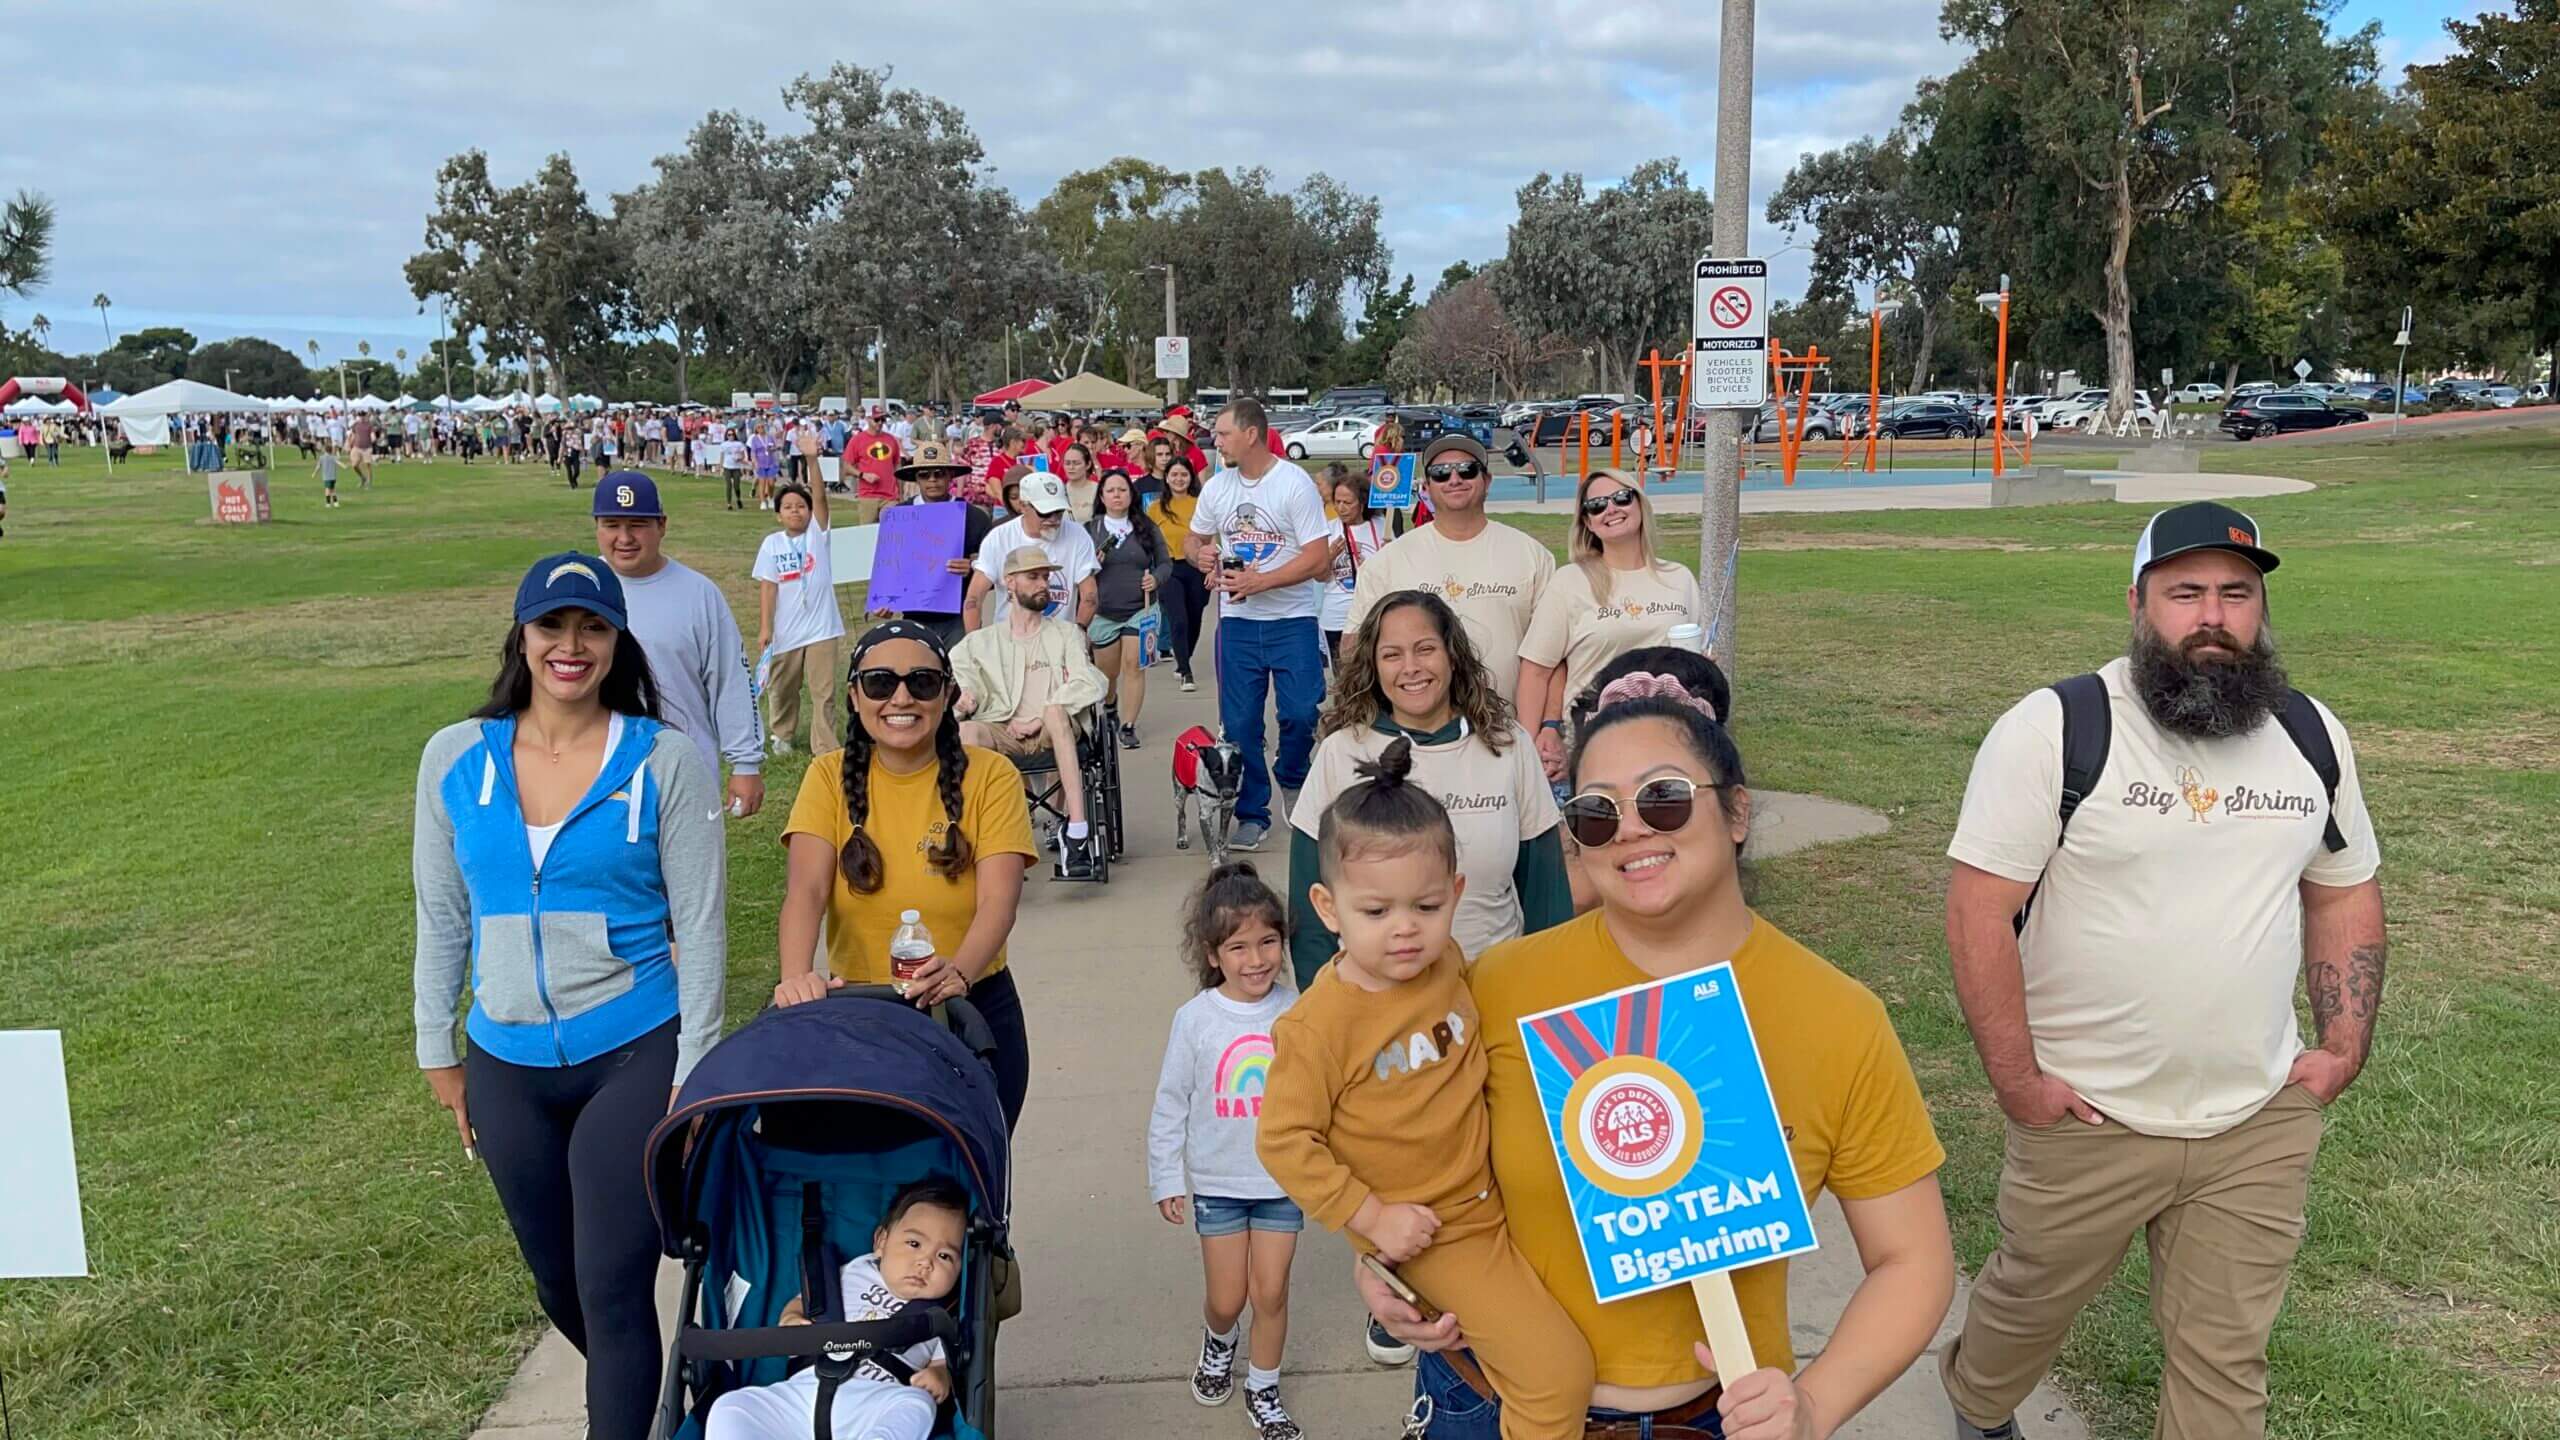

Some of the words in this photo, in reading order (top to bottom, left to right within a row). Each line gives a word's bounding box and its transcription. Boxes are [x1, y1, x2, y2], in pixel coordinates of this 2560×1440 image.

[1701, 264, 1763, 276] PROHIBITED
[1703, 339, 1758, 349] MOTORIZED
[1706, 367, 1754, 376] SCOOTERS
[1707, 359, 1753, 367] VEHICLES
[1707, 376, 1752, 384] BICYCLES
[1710, 385, 1750, 393] DEVICES
[616, 485, 635, 508] SD
[1466, 582, 1518, 599] Shrimp
[1597, 607, 1624, 620] Big
[1440, 792, 1509, 811] Shrimp
[2122, 781, 2178, 815] Big
[2224, 785, 2318, 817] Shrimp
[1693, 979, 1721, 998] ALS
[1597, 1100, 1613, 1130] WALK
[1611, 1091, 1625, 1102] TO
[1628, 1090, 1663, 1115] DEFEAT
[1618, 1123, 1655, 1148] ALS
[1593, 1200, 1671, 1244] TOP
[1676, 1170, 1782, 1223] TEAM
[1610, 1220, 1791, 1284] Bigshrimp
[833, 1339, 873, 1351] evenflo
